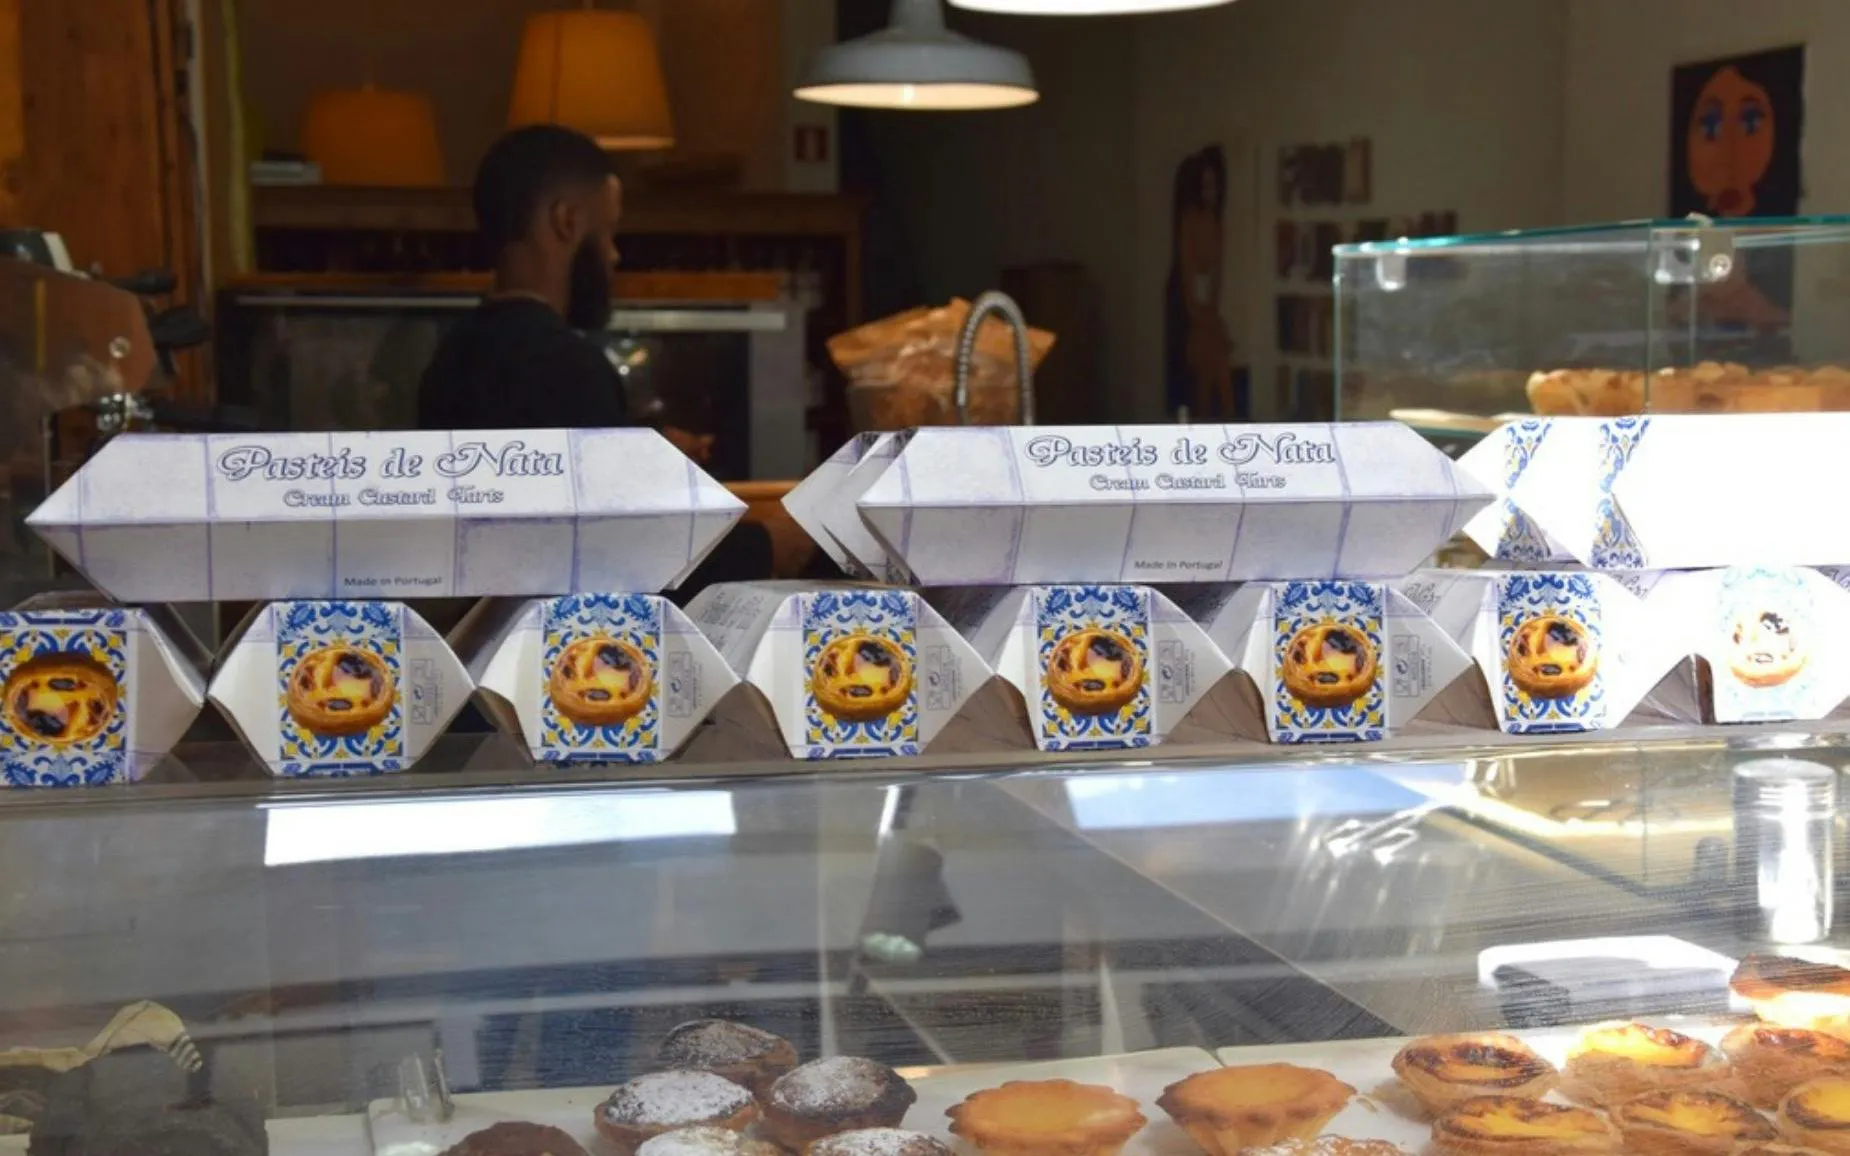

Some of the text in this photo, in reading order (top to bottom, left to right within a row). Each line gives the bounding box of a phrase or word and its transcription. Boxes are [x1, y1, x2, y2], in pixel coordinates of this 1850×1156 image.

[1171, 437, 1207, 465] de
[1218, 432, 1335, 464] Nata
[380, 447, 423, 478] de
[433, 441, 564, 478] Nata
[1089, 471, 1286, 491] Cream Custard Tarts
[283, 485, 504, 507] Cream Custard Tarts
[1134, 560, 1164, 570] Made
[1179, 560, 1224, 571] Portugal
[343, 577, 377, 587] Made
[394, 576, 443, 588] Portugal
